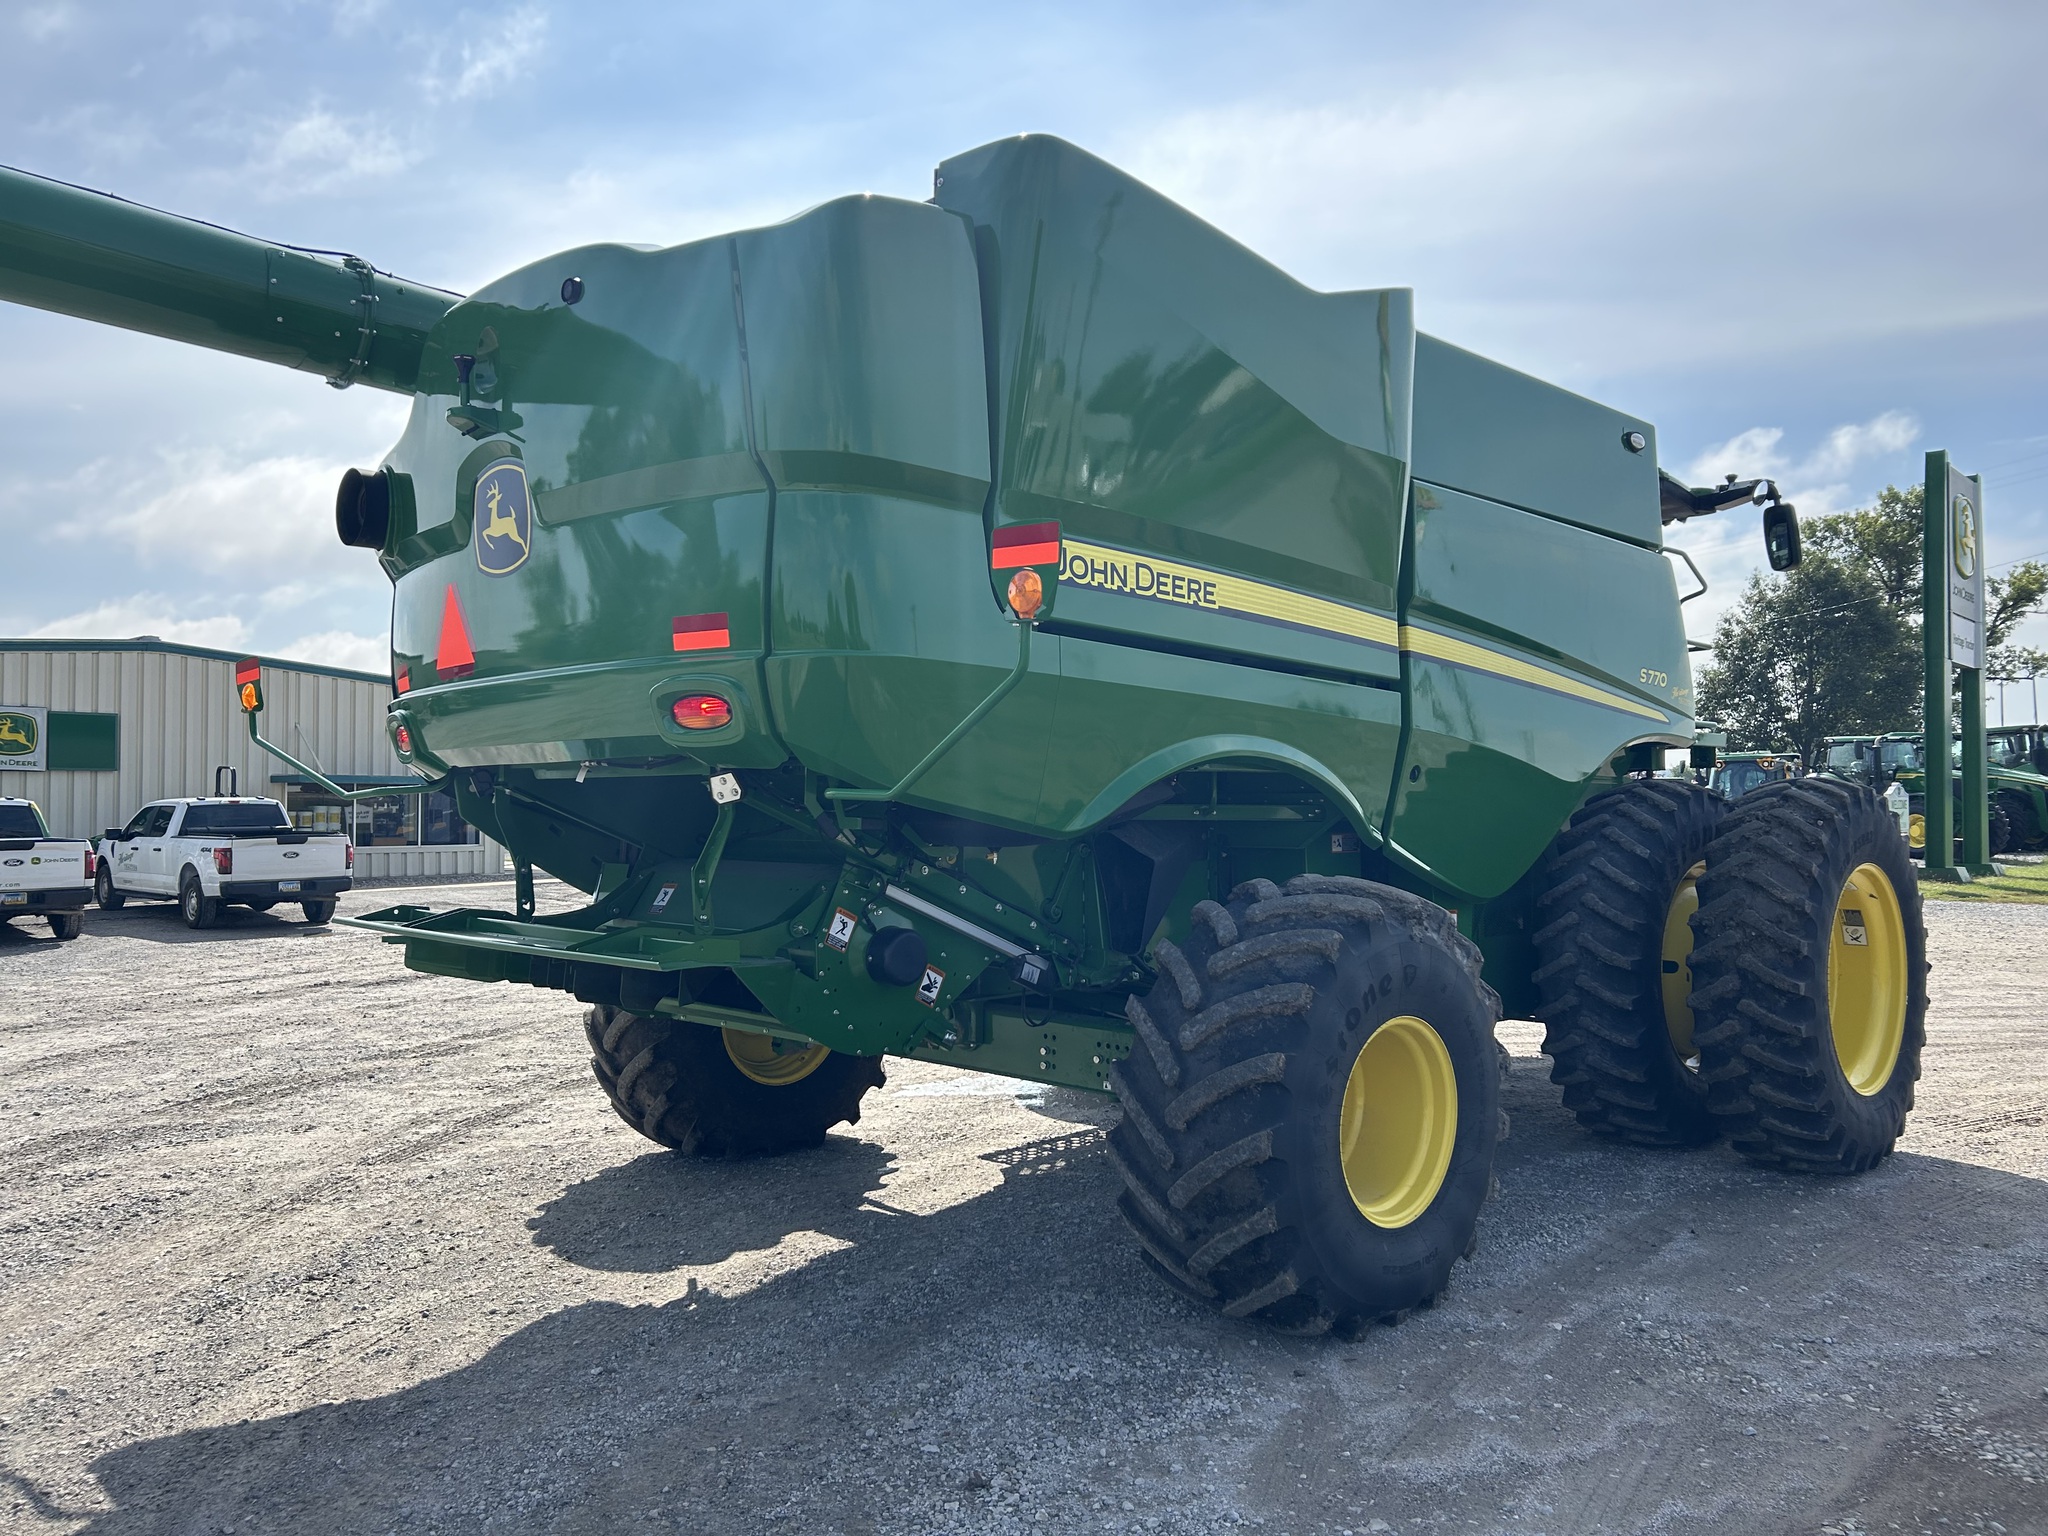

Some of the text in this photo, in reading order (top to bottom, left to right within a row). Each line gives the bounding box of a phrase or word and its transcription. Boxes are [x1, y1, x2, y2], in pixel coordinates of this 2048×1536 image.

[1059, 547, 1217, 605] JOHN DEERE
[1639, 668, 1668, 688] S770
[8, 759, 38, 767] DEERE
